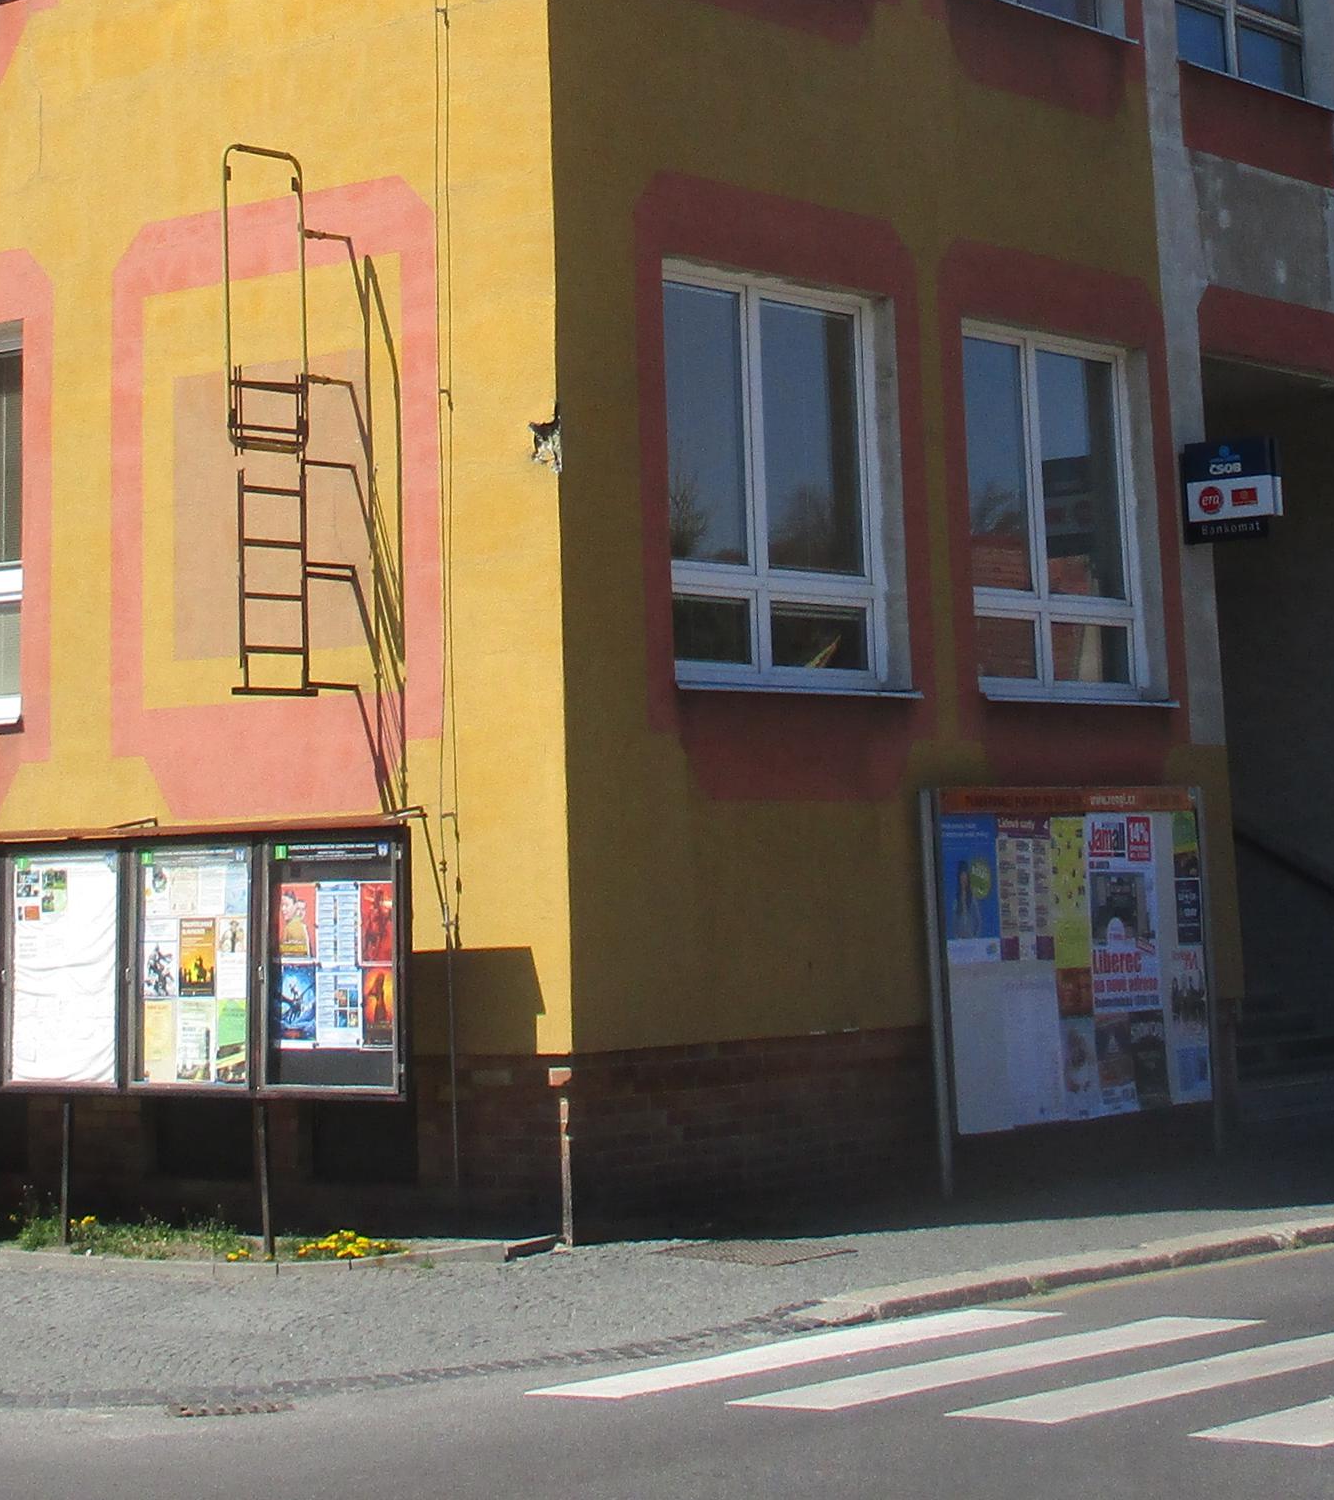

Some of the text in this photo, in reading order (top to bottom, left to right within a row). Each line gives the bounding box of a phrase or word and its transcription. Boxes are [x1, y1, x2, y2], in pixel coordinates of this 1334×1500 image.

[1201, 494, 1220, 506] era
[1201, 521, 1261, 536] Bankomat
[1093, 949, 1142, 974] Liberec
